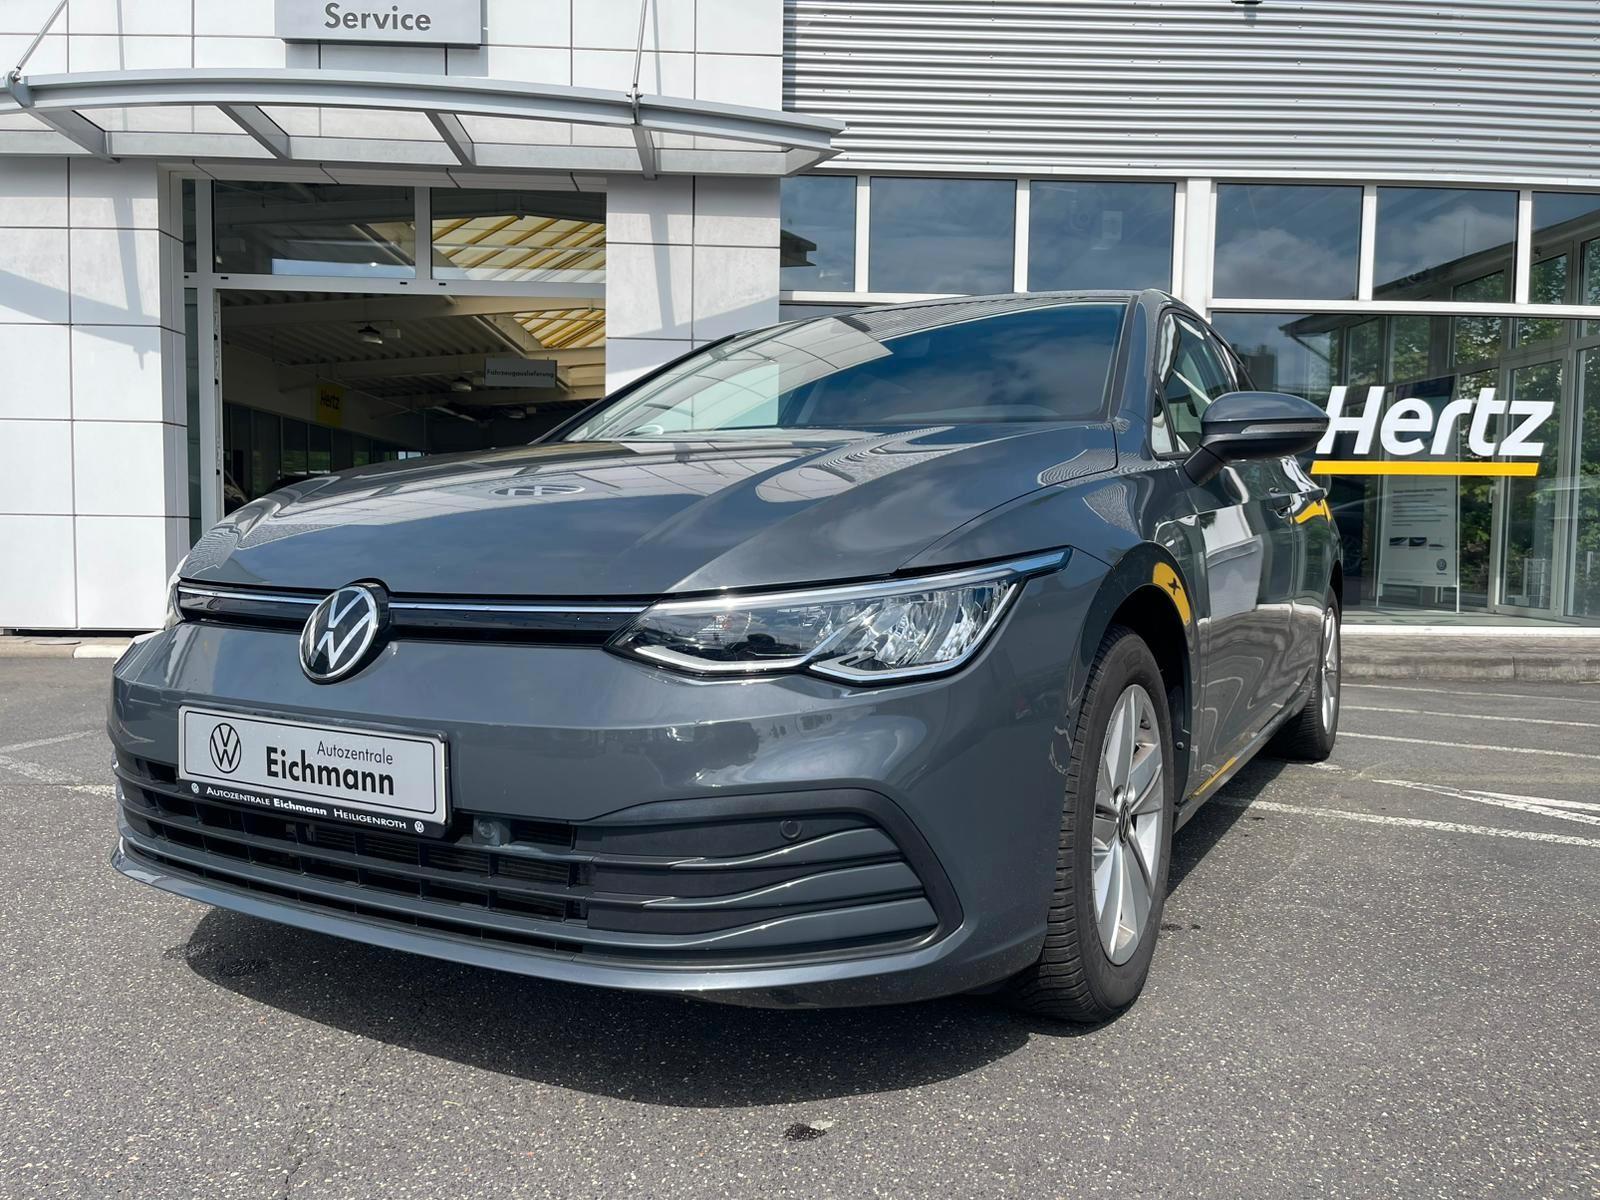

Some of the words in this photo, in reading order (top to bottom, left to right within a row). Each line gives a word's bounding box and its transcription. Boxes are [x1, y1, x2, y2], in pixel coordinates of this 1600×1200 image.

[324, 2, 432, 31] Service
[1315, 386, 1555, 457] Hertz
[317, 740, 394, 765] Autozentrale
[266, 746, 394, 796] Eichmann
[273, 798, 328, 816] Eichmann
[333, 808, 407, 829] HEILIGENROTH
